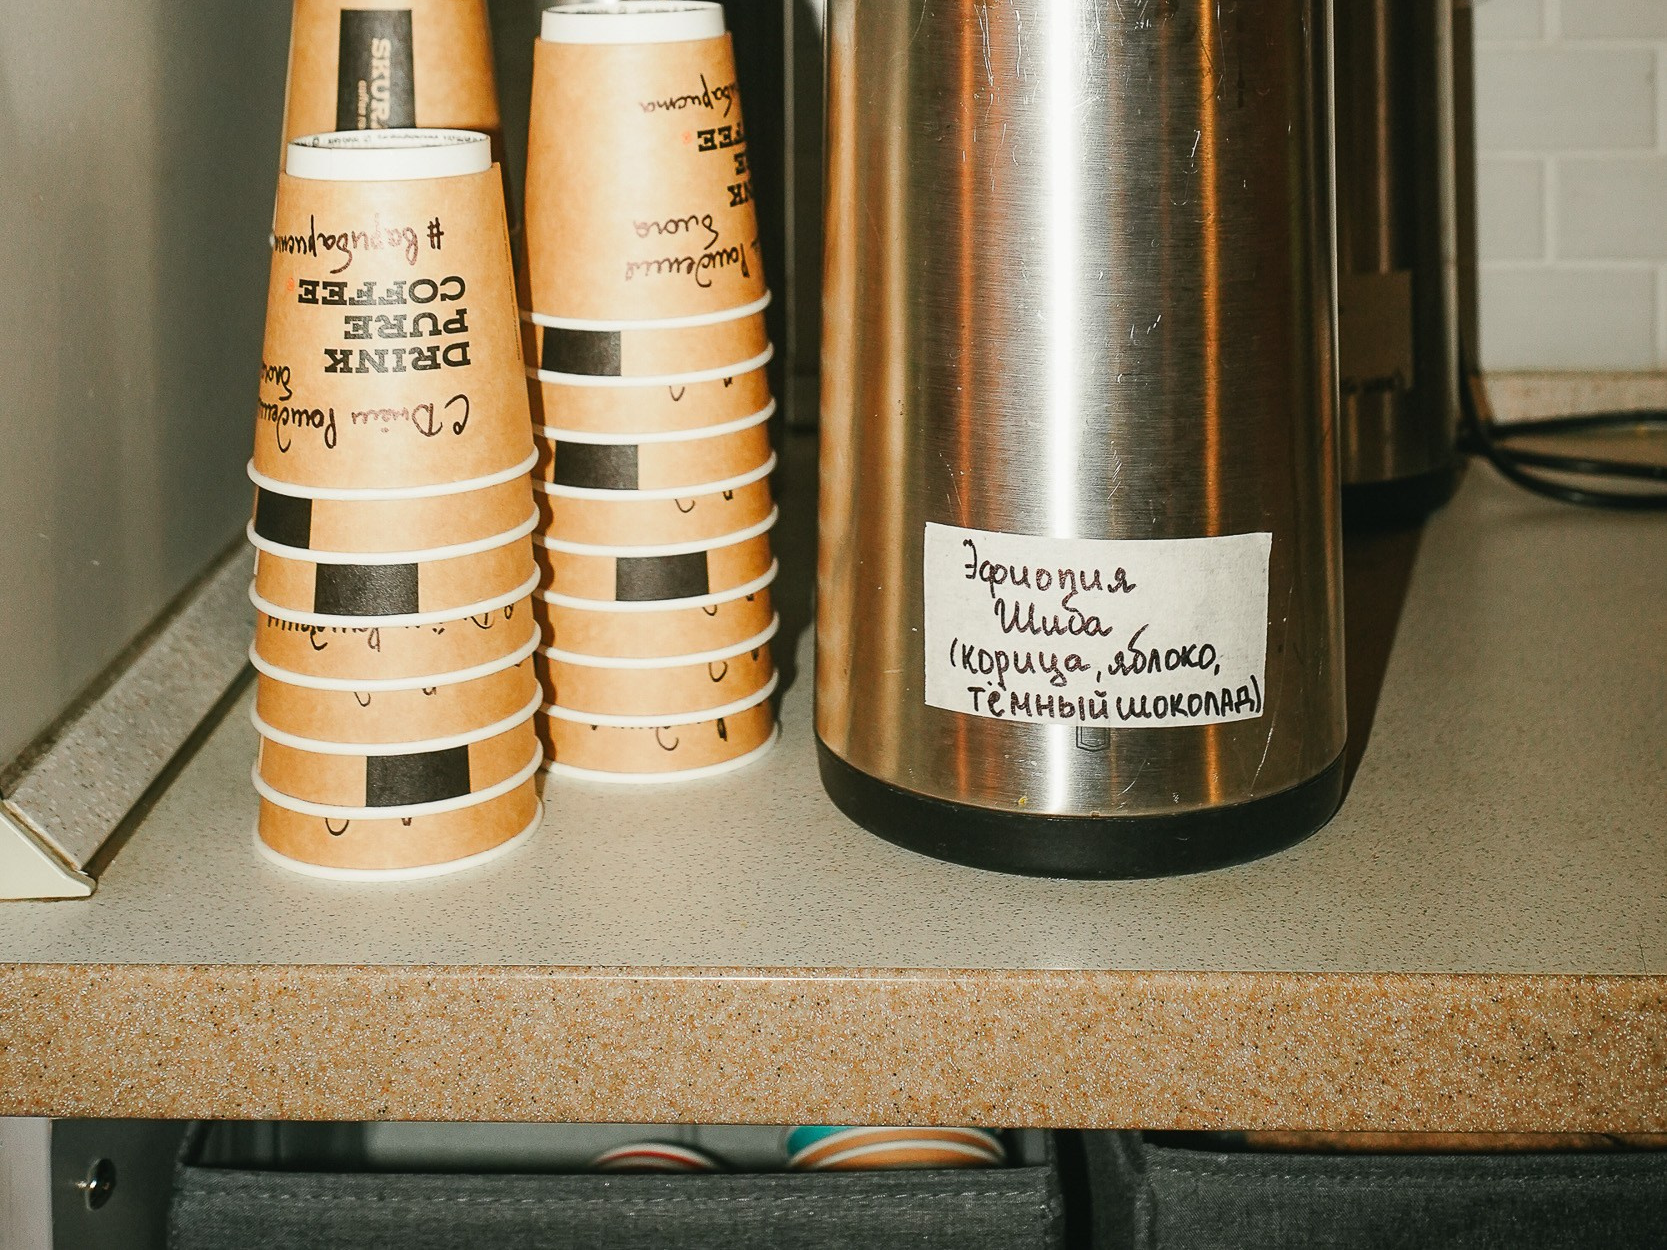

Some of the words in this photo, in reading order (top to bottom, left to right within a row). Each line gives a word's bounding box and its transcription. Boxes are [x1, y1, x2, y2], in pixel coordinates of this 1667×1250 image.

[344, 308, 468, 339] PURE
[324, 341, 471, 374] DRINK
[444, 394, 470, 436] С
[963, 538, 1137, 598] Эфиопия
[994, 590, 1114, 636] Шиба
